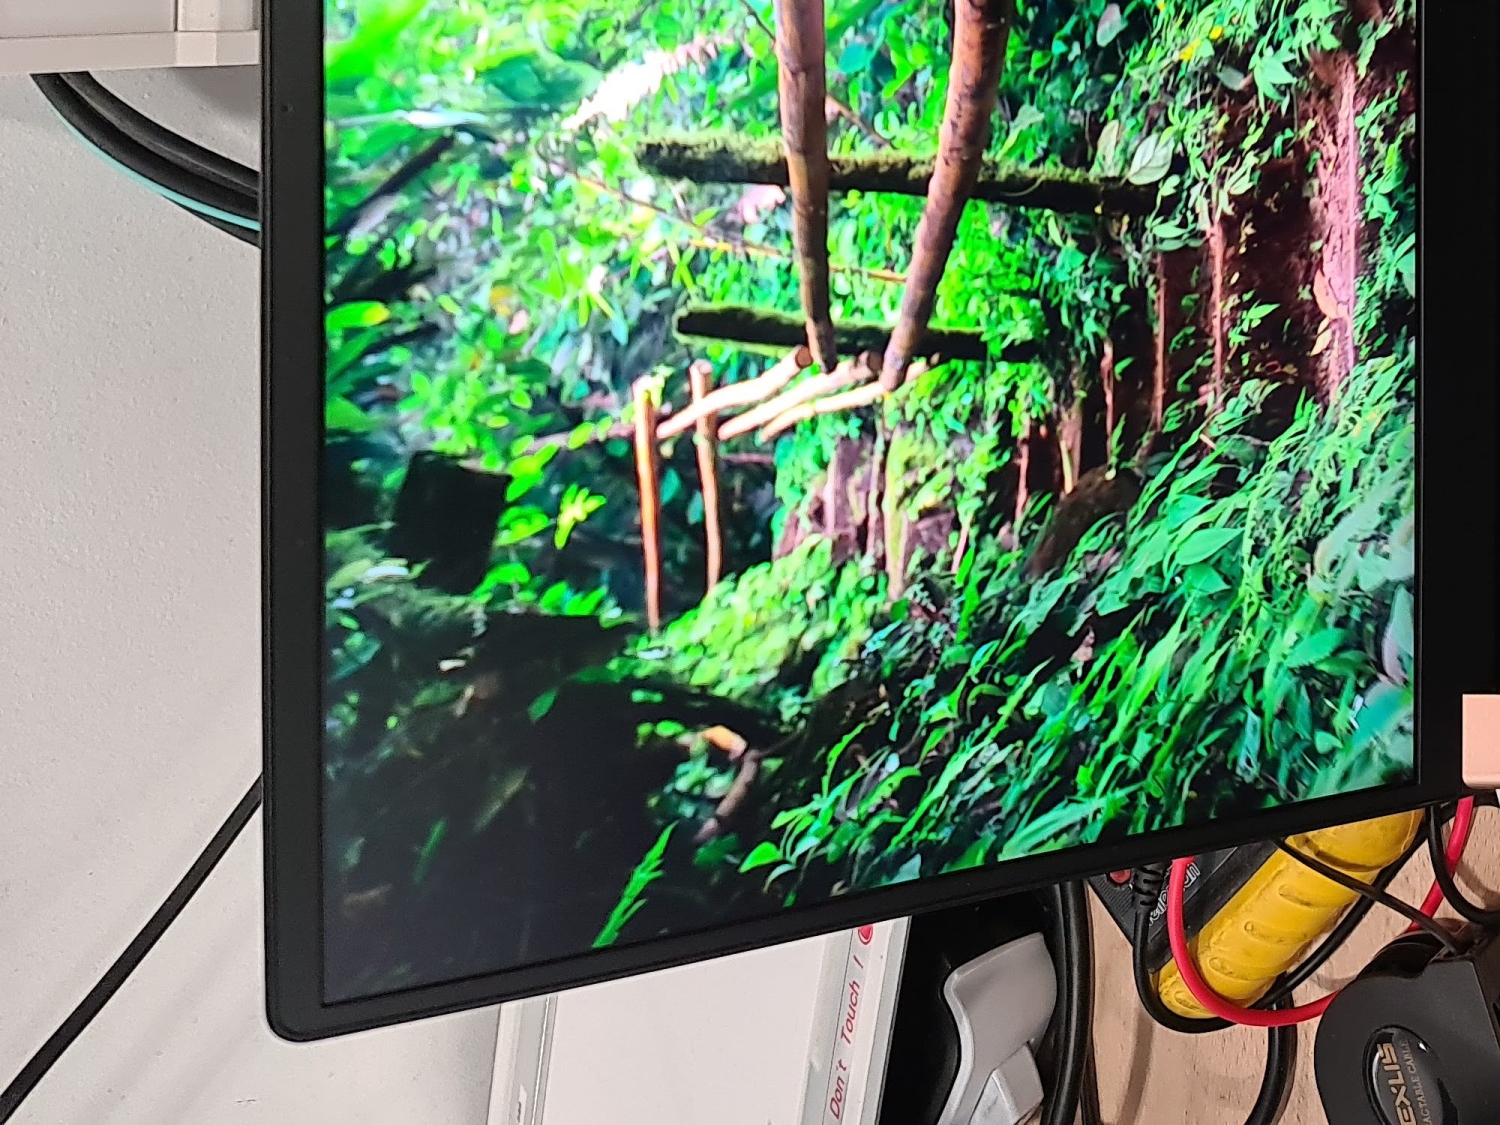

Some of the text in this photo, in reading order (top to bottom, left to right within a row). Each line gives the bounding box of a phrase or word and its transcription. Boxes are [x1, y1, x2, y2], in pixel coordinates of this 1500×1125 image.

[830, 1059, 847, 1119] Don't
[840, 981, 860, 1044] Touch
[1401, 1040, 1432, 1125] ACTABLE CABLE
